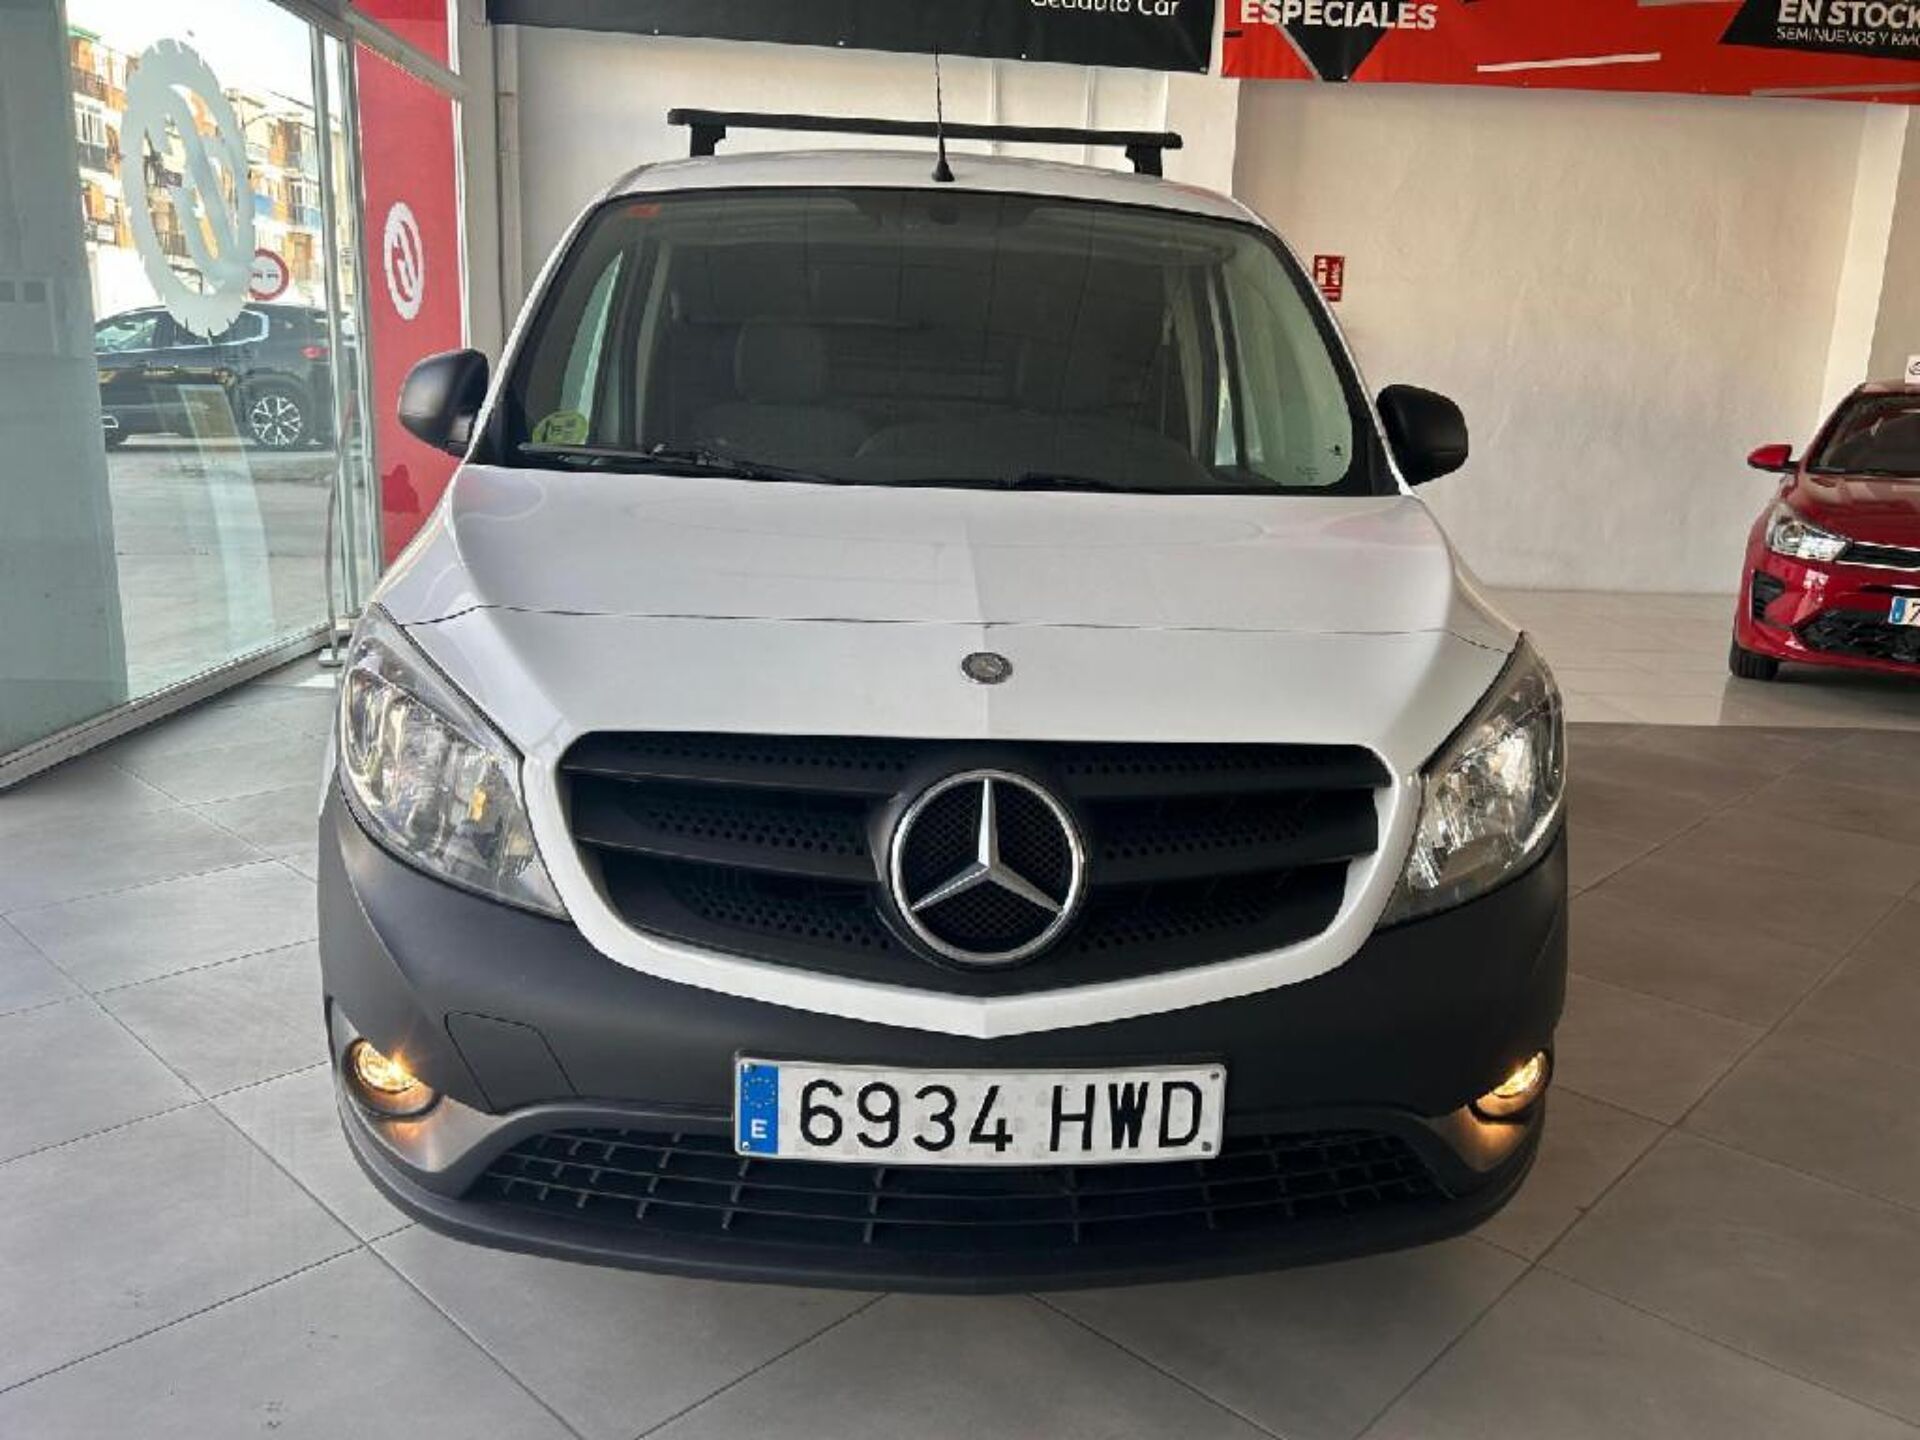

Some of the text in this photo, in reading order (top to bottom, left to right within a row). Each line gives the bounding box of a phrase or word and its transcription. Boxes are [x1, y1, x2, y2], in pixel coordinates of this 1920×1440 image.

[1138, 0, 1180, 16] Car
[1240, 0, 1439, 31] ESPECIALES
[1777, 0, 1920, 30] EN STOCK
[1776, 26, 1876, 46] SEMINUEVOS
[1879, 31, 1889, 45] Y
[751, 1078, 1203, 1153] E 6934 HWD
